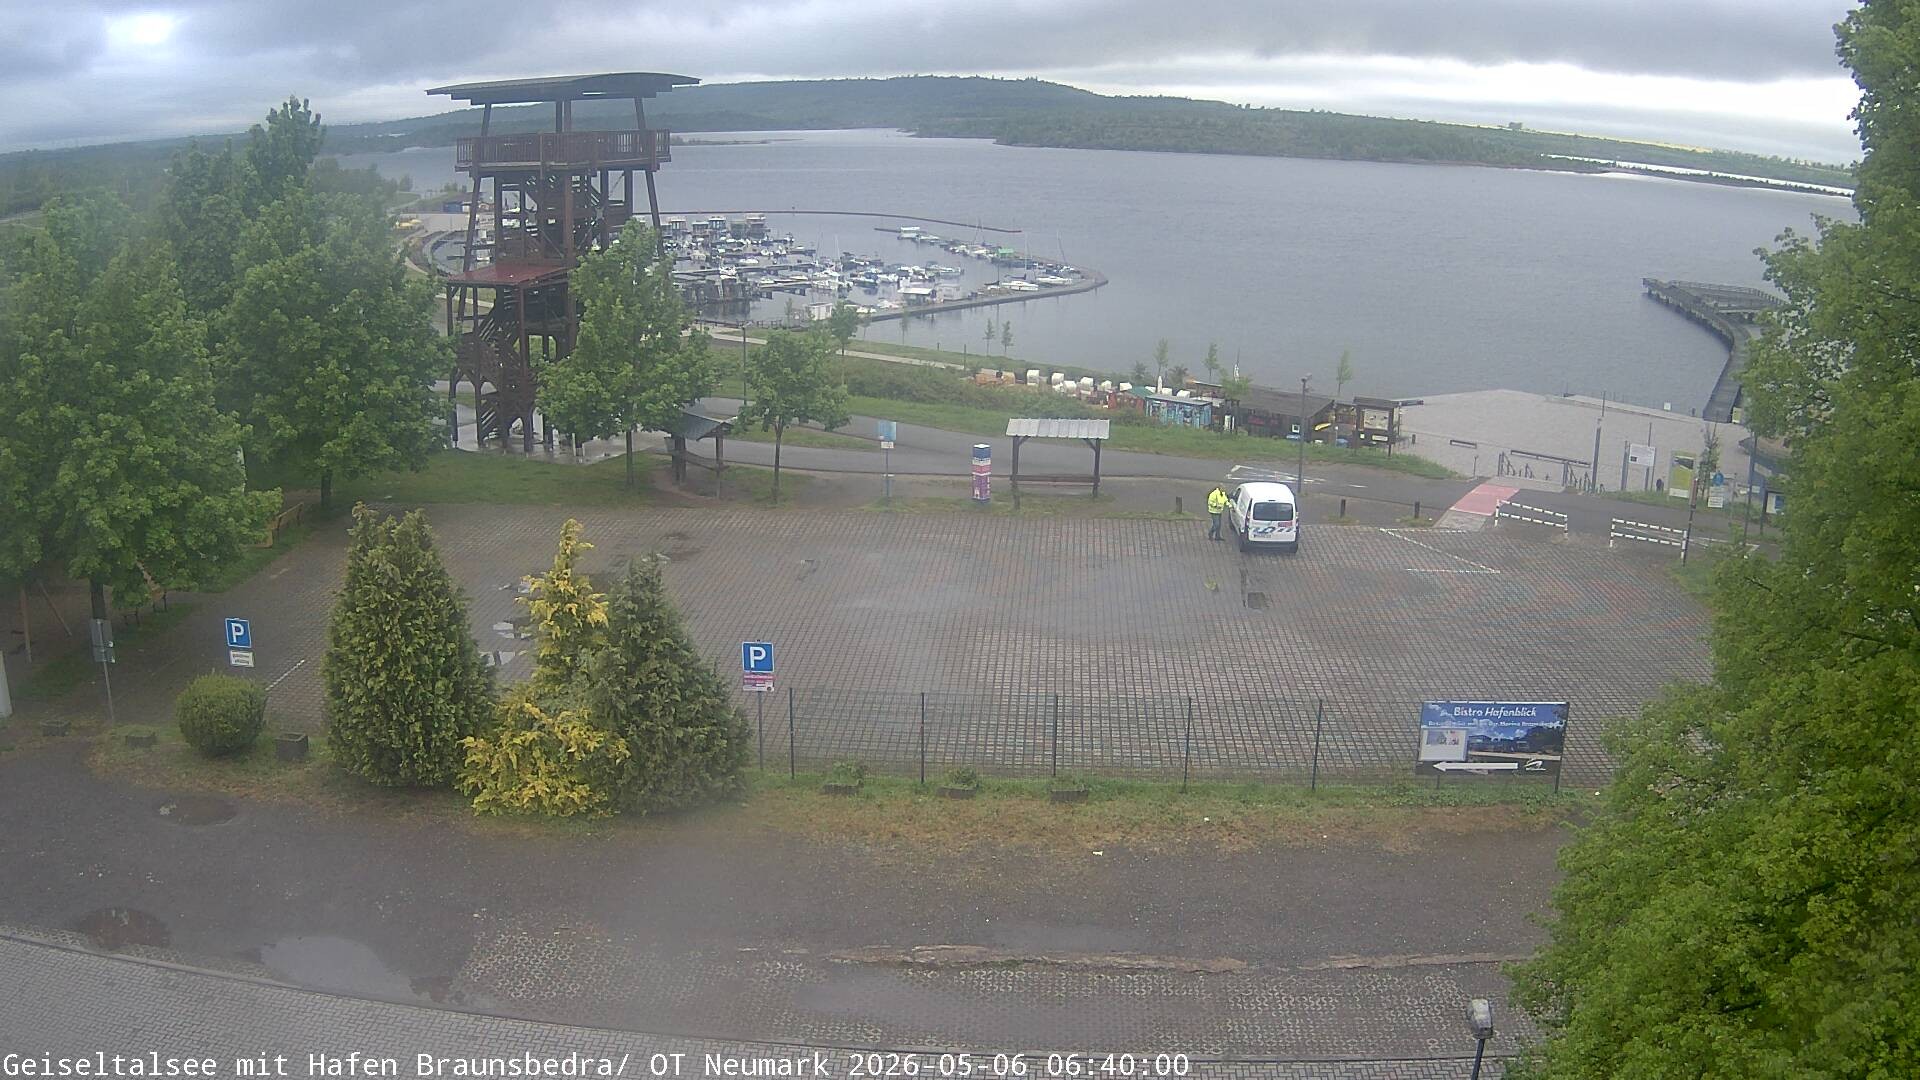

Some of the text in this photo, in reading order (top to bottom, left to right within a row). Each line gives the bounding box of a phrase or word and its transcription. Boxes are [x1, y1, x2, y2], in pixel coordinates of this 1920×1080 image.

[231, 622, 245, 643] P
[750, 646, 766, 668] P
[1453, 706, 1537, 719] Bistro Hafenblick
